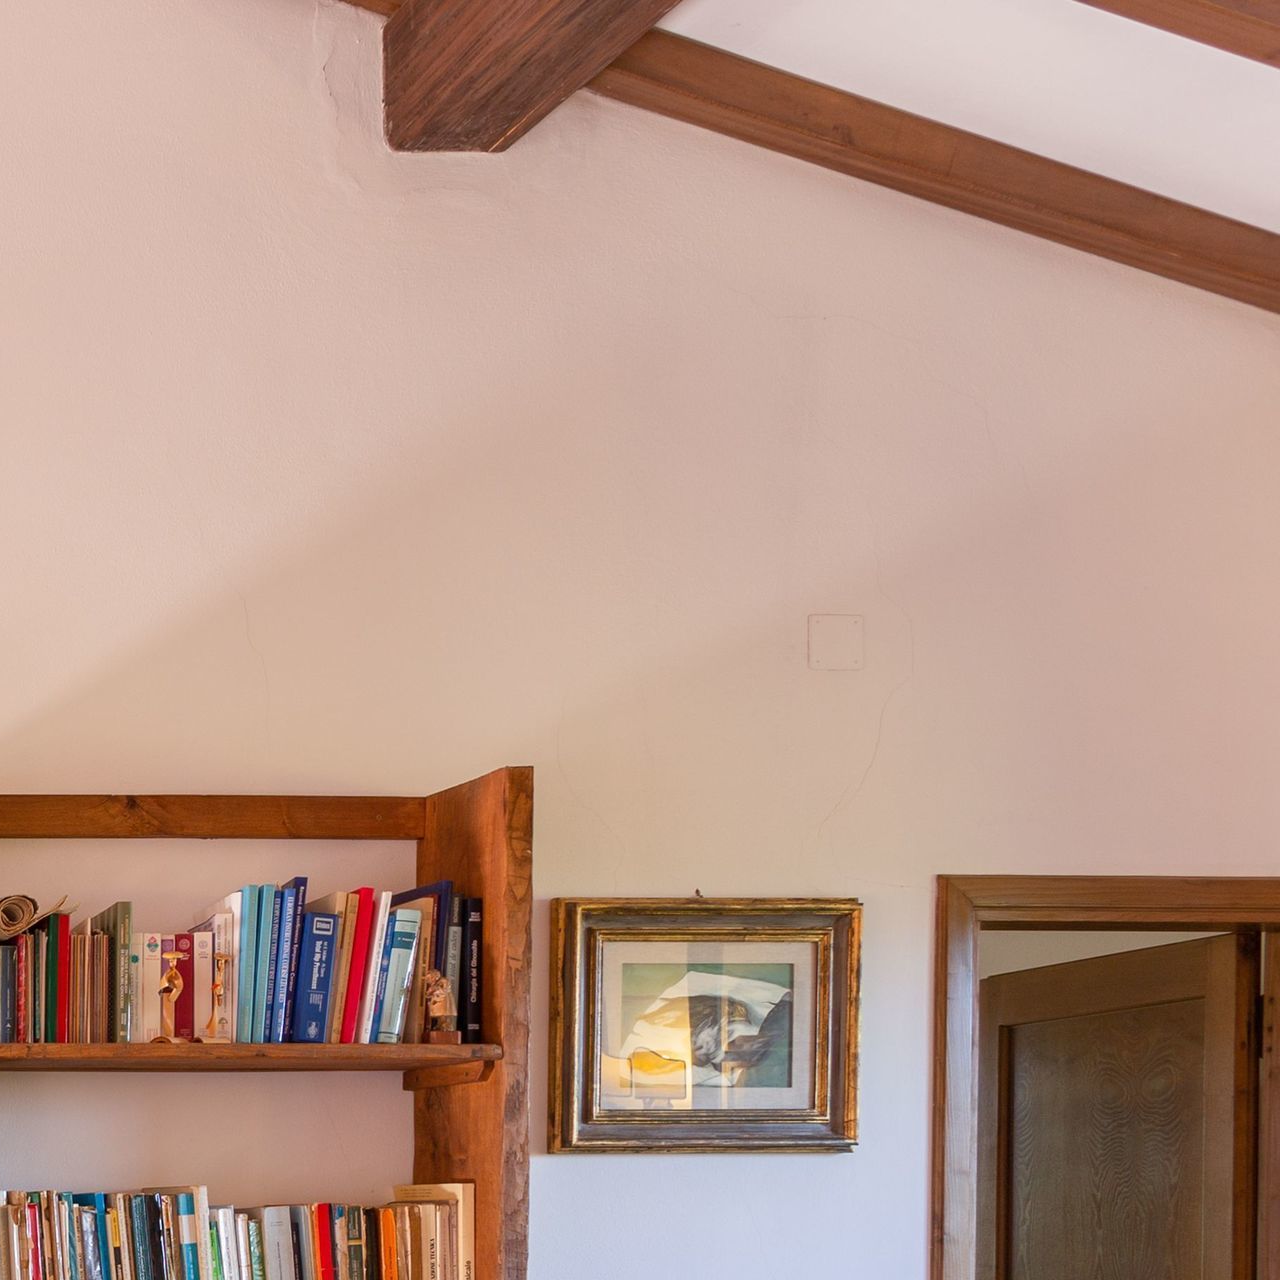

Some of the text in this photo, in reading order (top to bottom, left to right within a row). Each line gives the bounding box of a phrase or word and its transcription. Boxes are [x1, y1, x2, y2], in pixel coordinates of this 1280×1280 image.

[313, 953, 321, 962] Hip
[470, 939, 478, 968] Ginocchio
[311, 962, 320, 990] Prostheses
[470, 978, 478, 1003] Chirurgia
